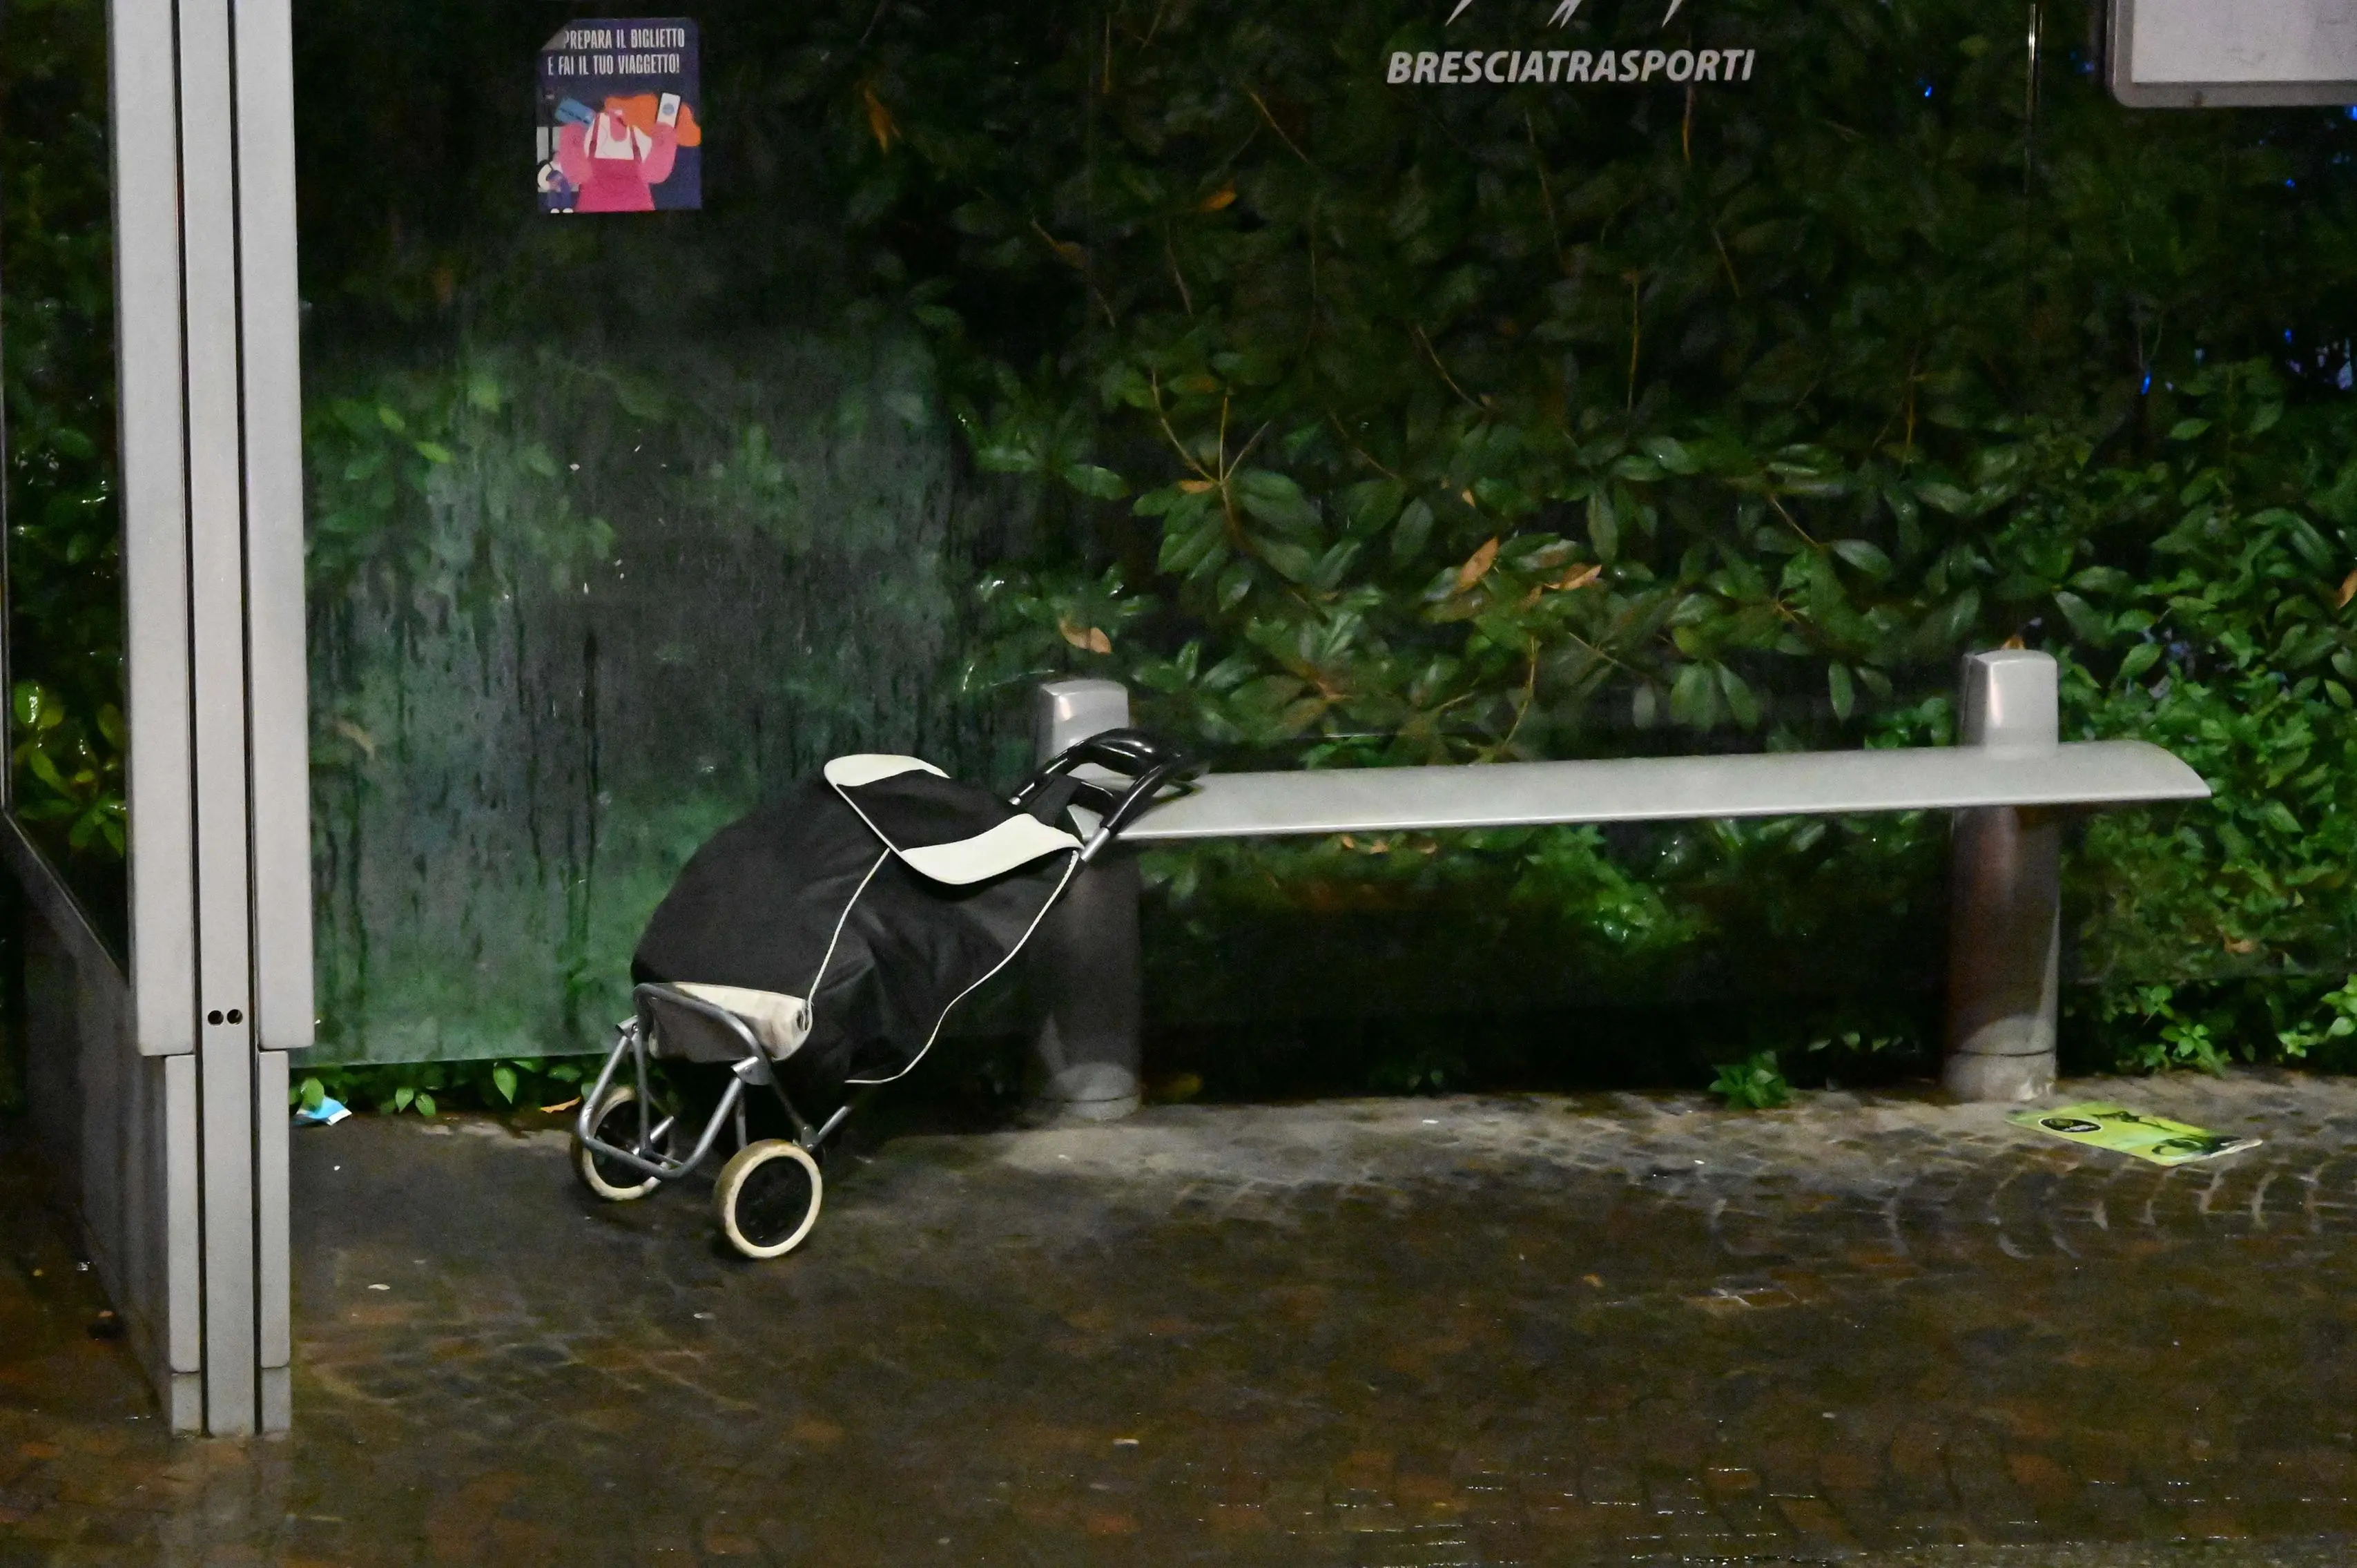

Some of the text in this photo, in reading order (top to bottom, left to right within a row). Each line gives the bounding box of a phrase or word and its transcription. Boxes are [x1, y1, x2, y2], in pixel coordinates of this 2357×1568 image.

[617, 29, 627, 48] IL
[630, 28, 685, 48] BIGLIETTO
[547, 53, 680, 75] E FAI IL TUO VIAGGETTO!
[1386, 49, 1756, 84] BRESCIATRASPORTI
